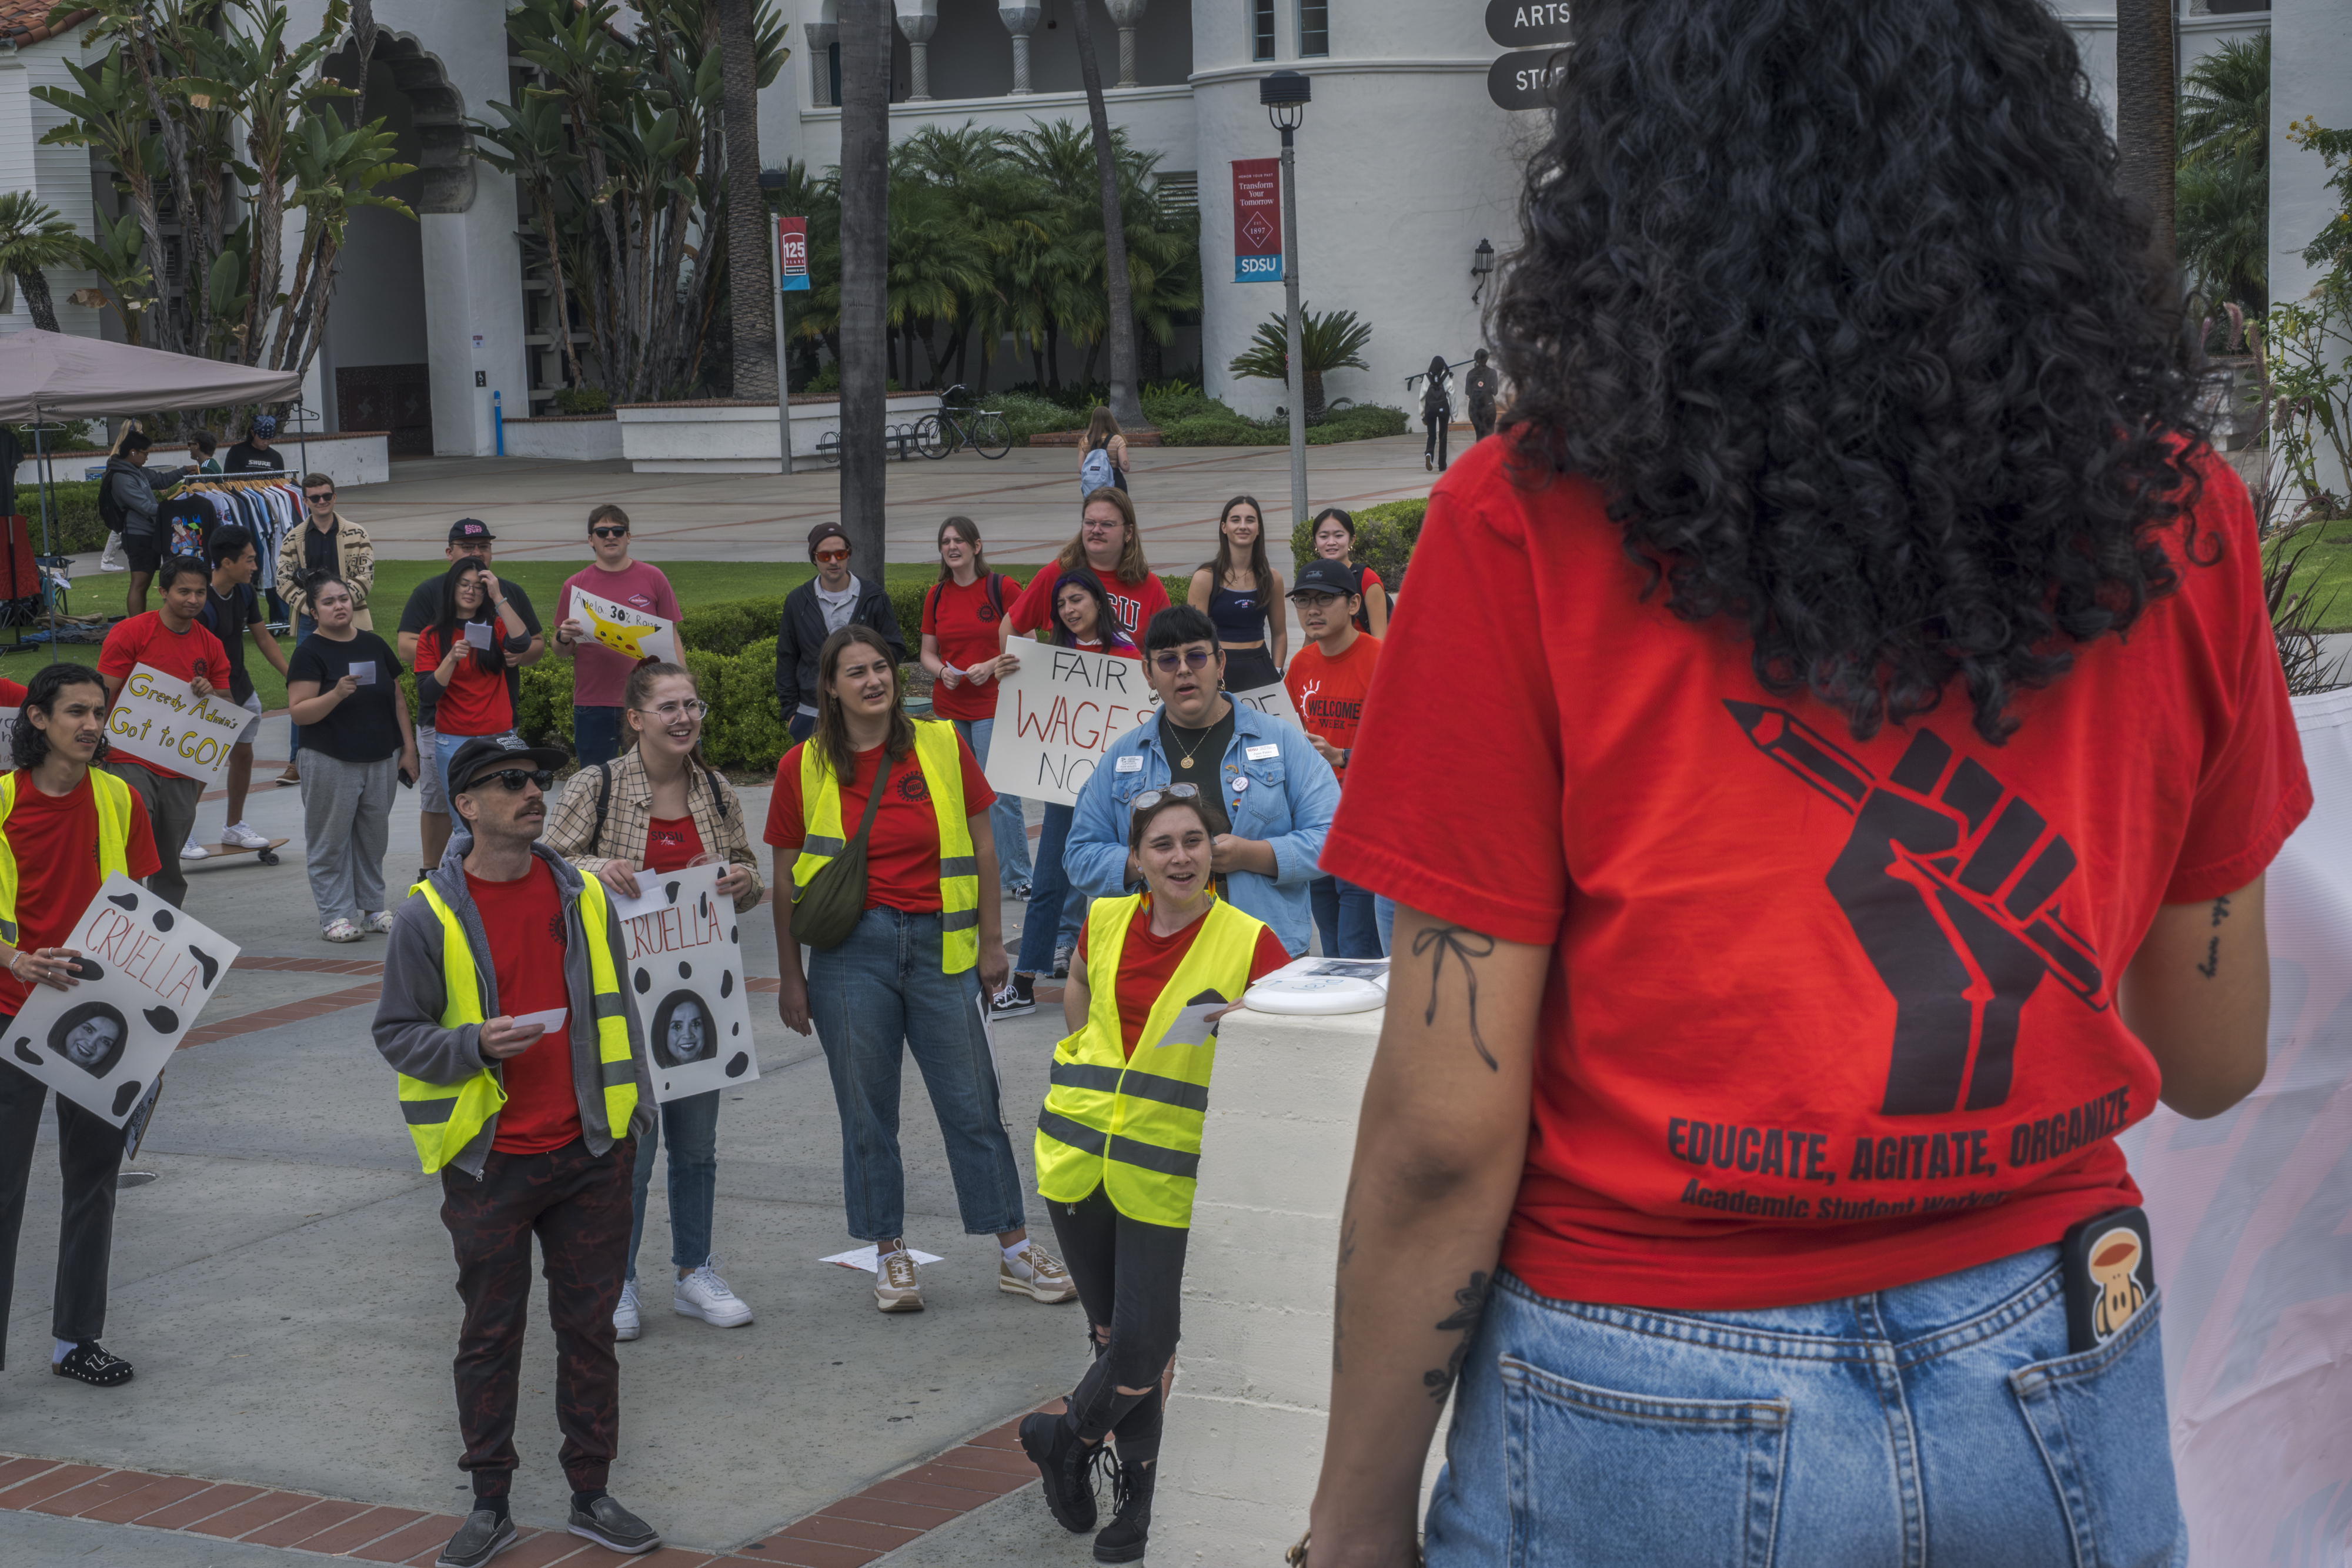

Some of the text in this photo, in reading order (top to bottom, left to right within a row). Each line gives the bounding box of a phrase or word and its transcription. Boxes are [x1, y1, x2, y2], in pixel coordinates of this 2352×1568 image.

[1514, 2, 1571, 28] ARTS
[1238, 181, 1274, 190] Transform
[1240, 198, 1274, 206] Tomorrow
[784, 242, 805, 258] 125
[1241, 258, 1276, 273] SDSU
[573, 591, 658, 627] Adela: 30% Raise
[1052, 651, 1127, 694] FAIR
[128, 673, 187, 713] Greedy
[1308, 699, 1361, 720] WELCOME
[1318, 718, 1345, 730] WEEK
[109, 707, 231, 772] Got to GO!
[650, 831, 686, 842] SDSU
[86, 908, 198, 1007] CRUELLA
[1667, 1084, 2130, 1186] EDUCATE, AGITATE, ORGANIZE
[1680, 1178, 1810, 1219] Academic
[1922, 1190, 2015, 1212] Worker
